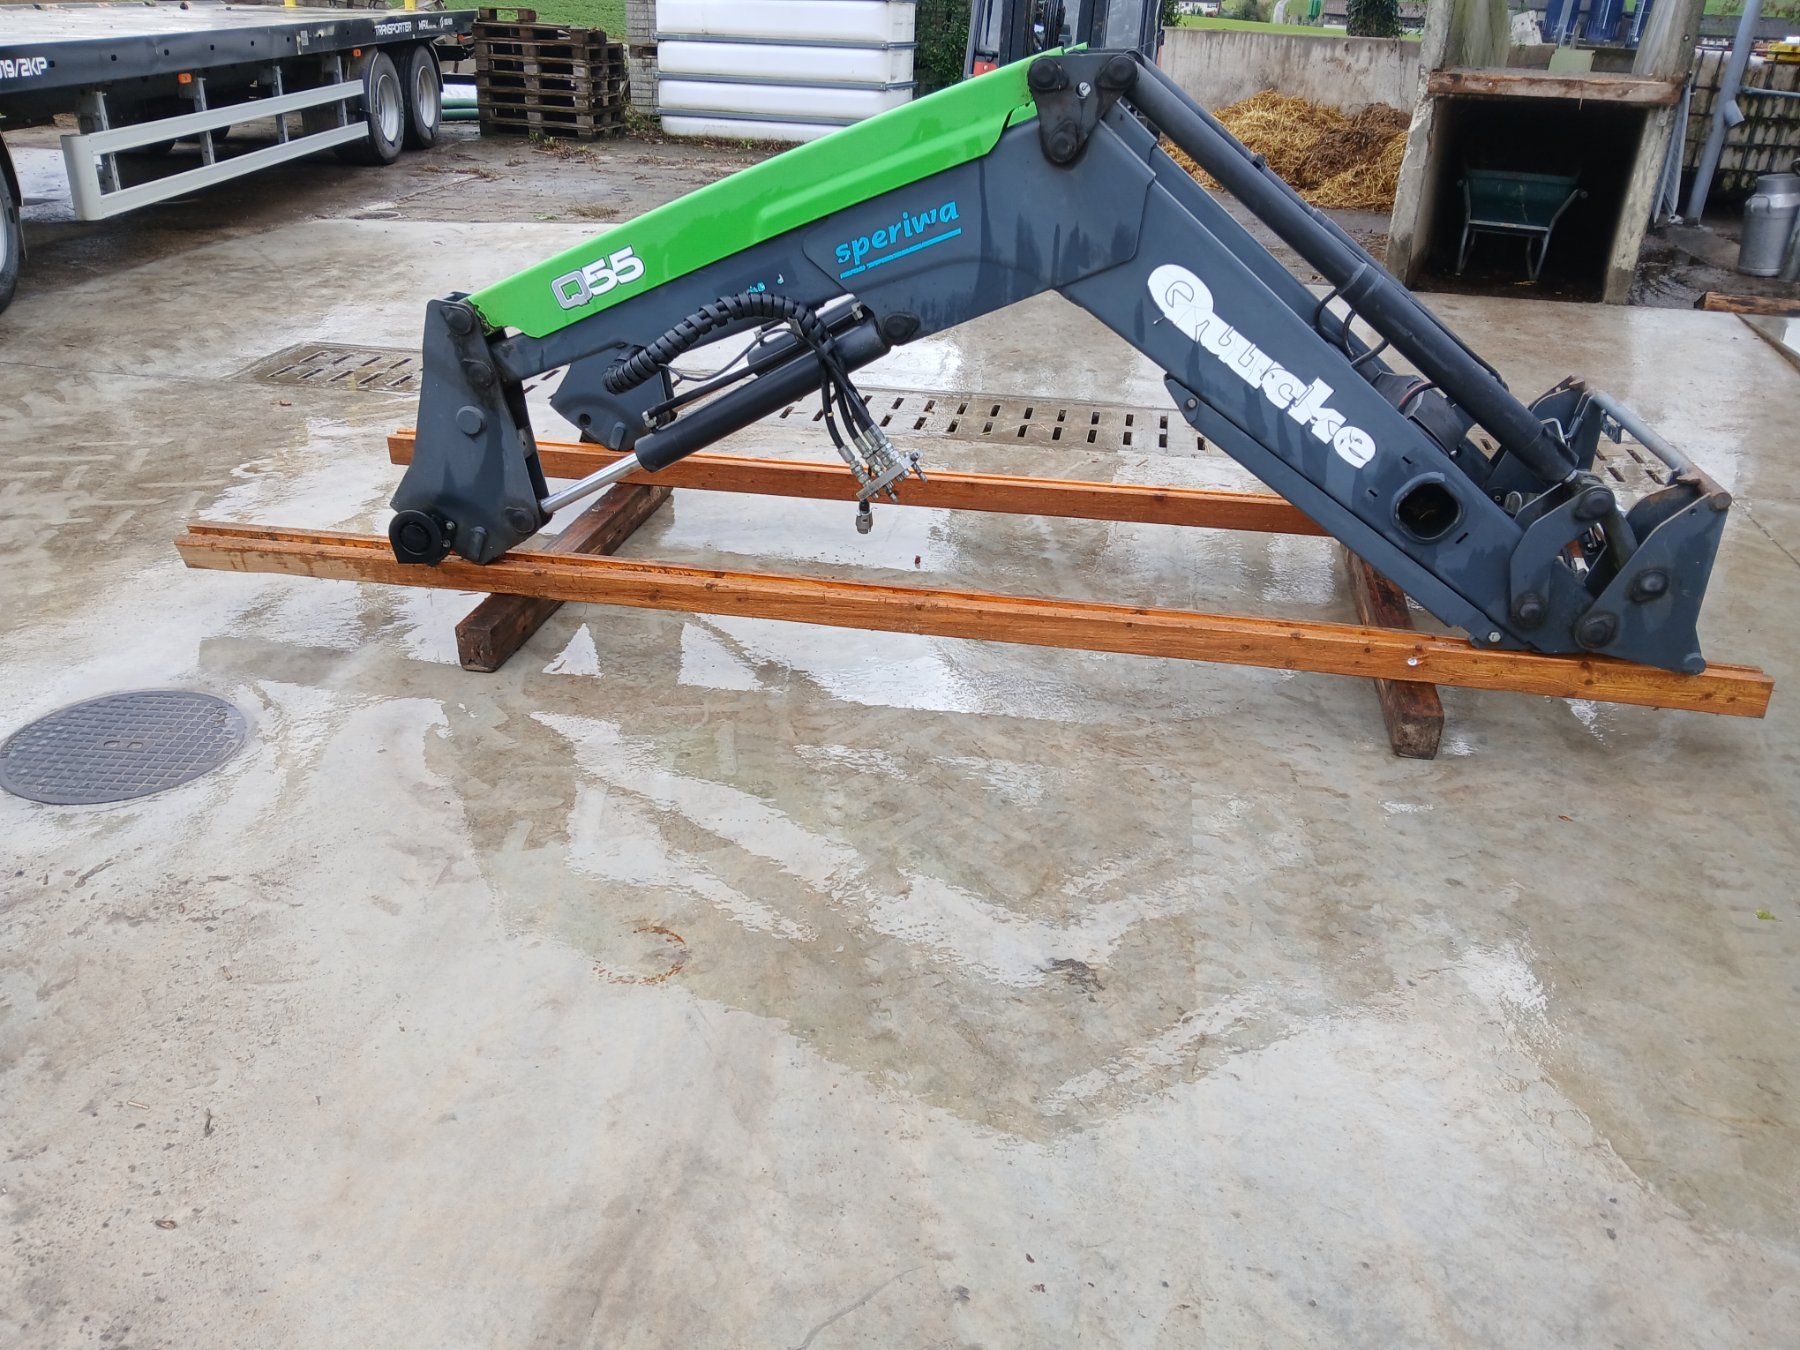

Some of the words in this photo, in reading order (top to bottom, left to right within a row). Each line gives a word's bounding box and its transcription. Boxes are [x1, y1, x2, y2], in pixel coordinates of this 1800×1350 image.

[374, 22, 412, 36] TRANSPORTER
[835, 200, 960, 266] speriwa
[550, 244, 646, 310] Q55
[1147, 263, 1376, 469] Quicke
